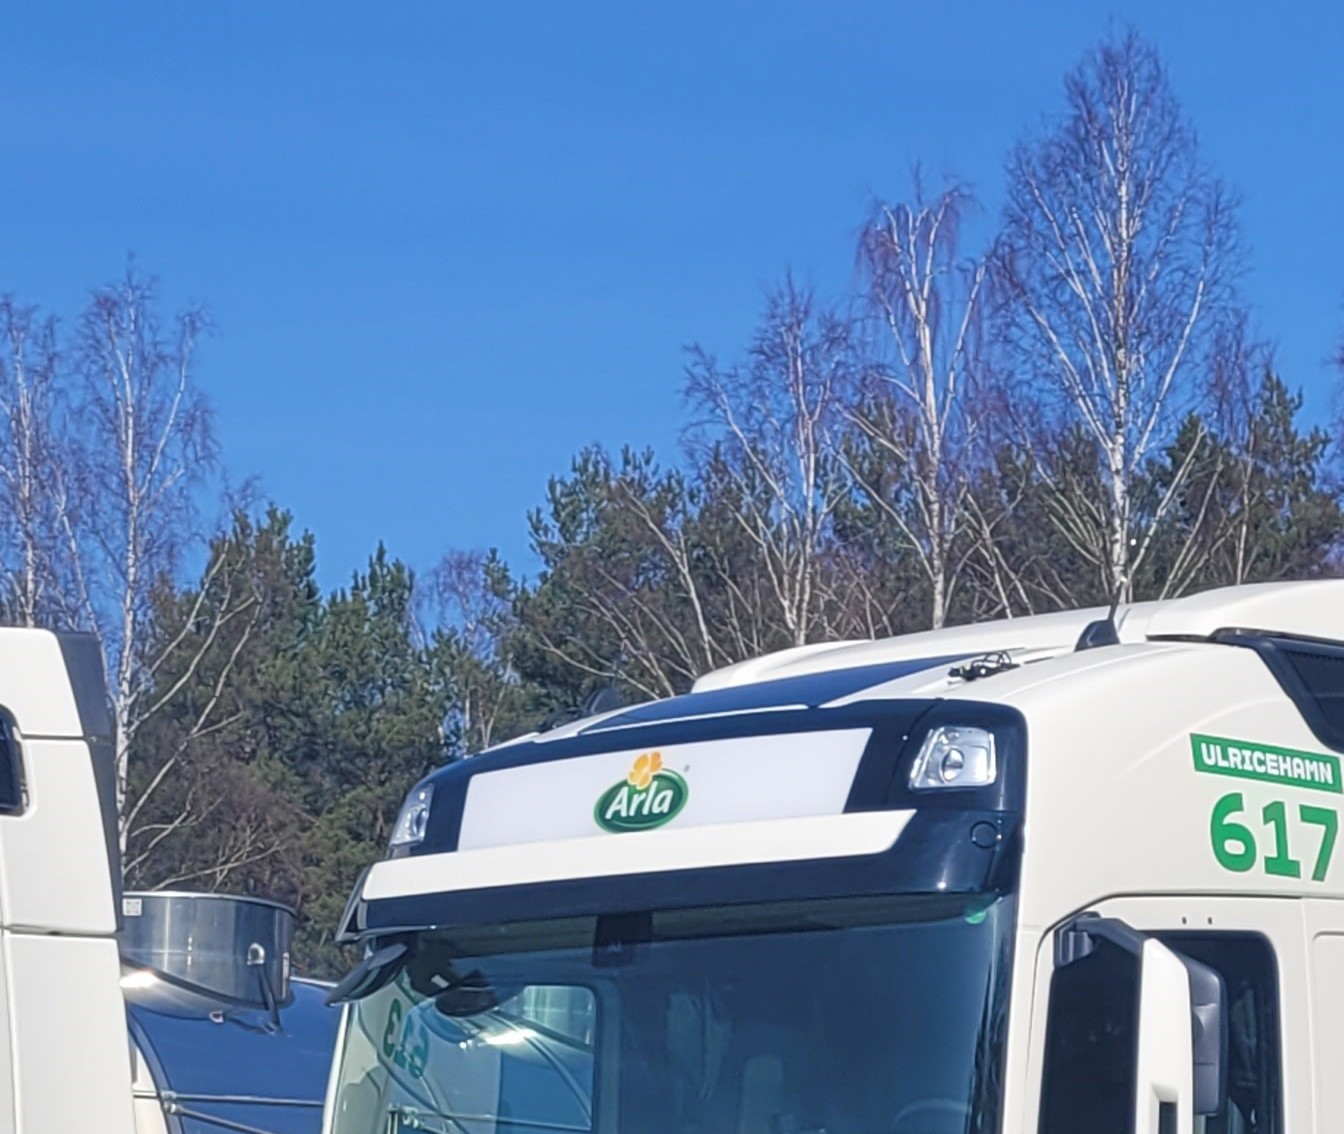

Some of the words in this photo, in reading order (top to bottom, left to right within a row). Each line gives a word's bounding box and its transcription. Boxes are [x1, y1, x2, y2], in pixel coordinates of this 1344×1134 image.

[1201, 742, 1334, 785] ULRICEHAMN
[604, 780, 674, 820] Arla
[1209, 792, 1339, 883] 617
